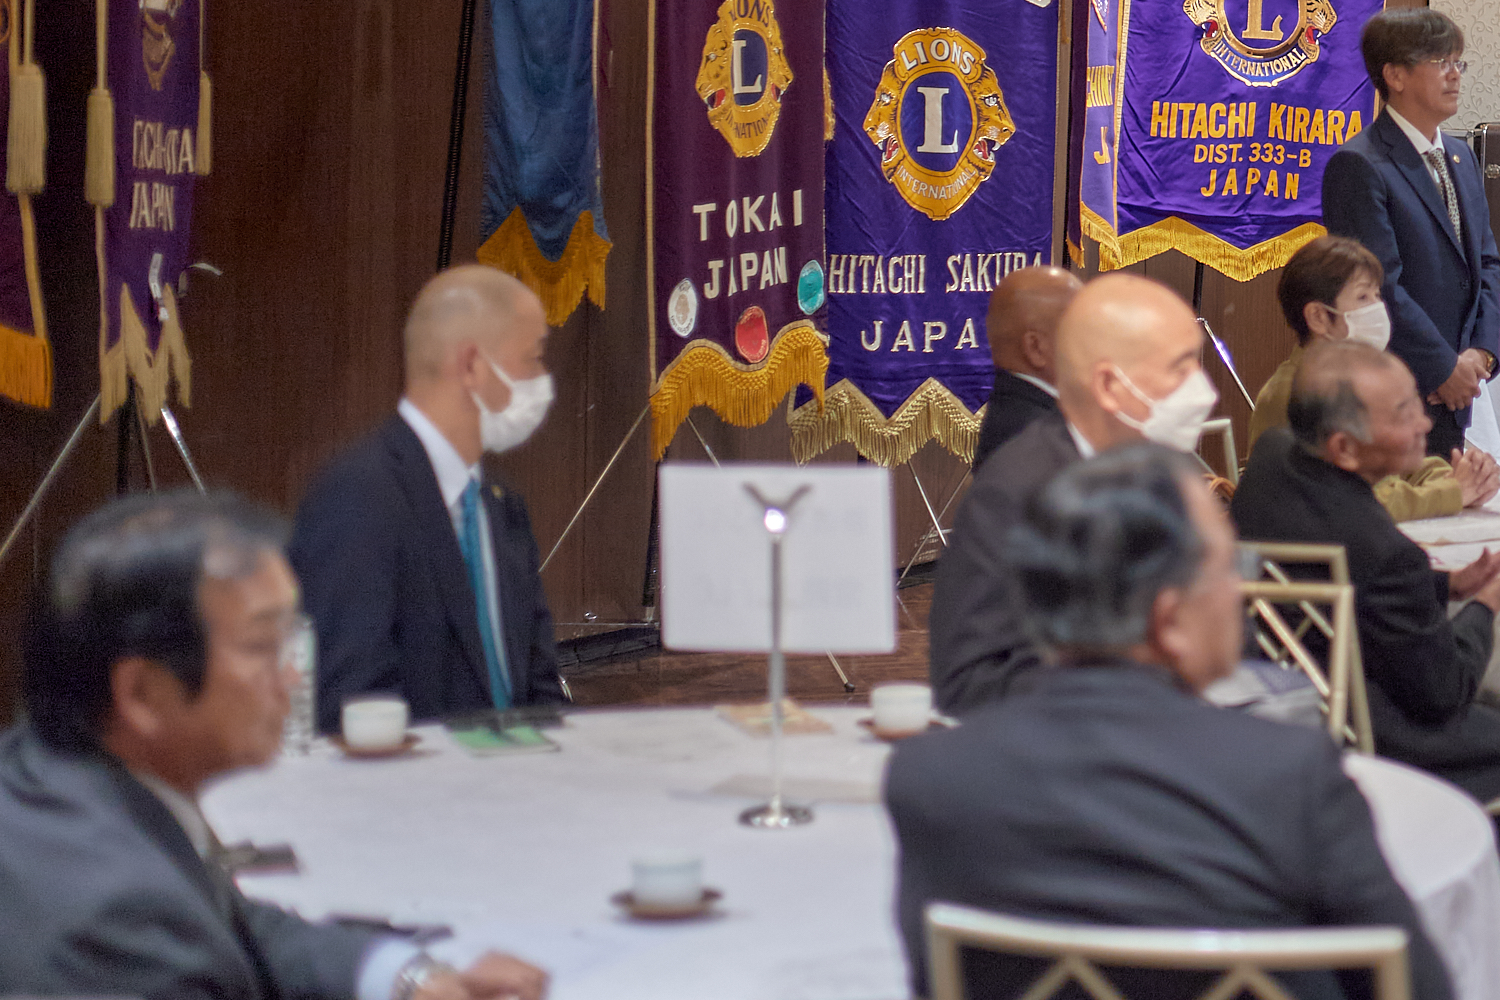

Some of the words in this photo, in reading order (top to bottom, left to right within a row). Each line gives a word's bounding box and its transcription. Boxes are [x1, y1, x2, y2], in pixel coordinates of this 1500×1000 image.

[732, 40, 762, 94] L
[900, 39, 975, 74] LIONS
[1214, 40, 1307, 78] INTERNATIONAL
[917, 86, 959, 153] L
[1150, 100, 1256, 139] HITACHI
[1269, 102, 1362, 147] KIRARA
[1194, 143, 1244, 165] DIST.
[1250, 143, 1311, 168] 333-B
[897, 166, 976, 200] INTERNATIONAL
[1200, 168, 1300, 200] JAPAN
[693, 190, 802, 241] TOKAI
[704, 246, 788, 299] JAPAN
[828, 253, 926, 295] HITACHI
